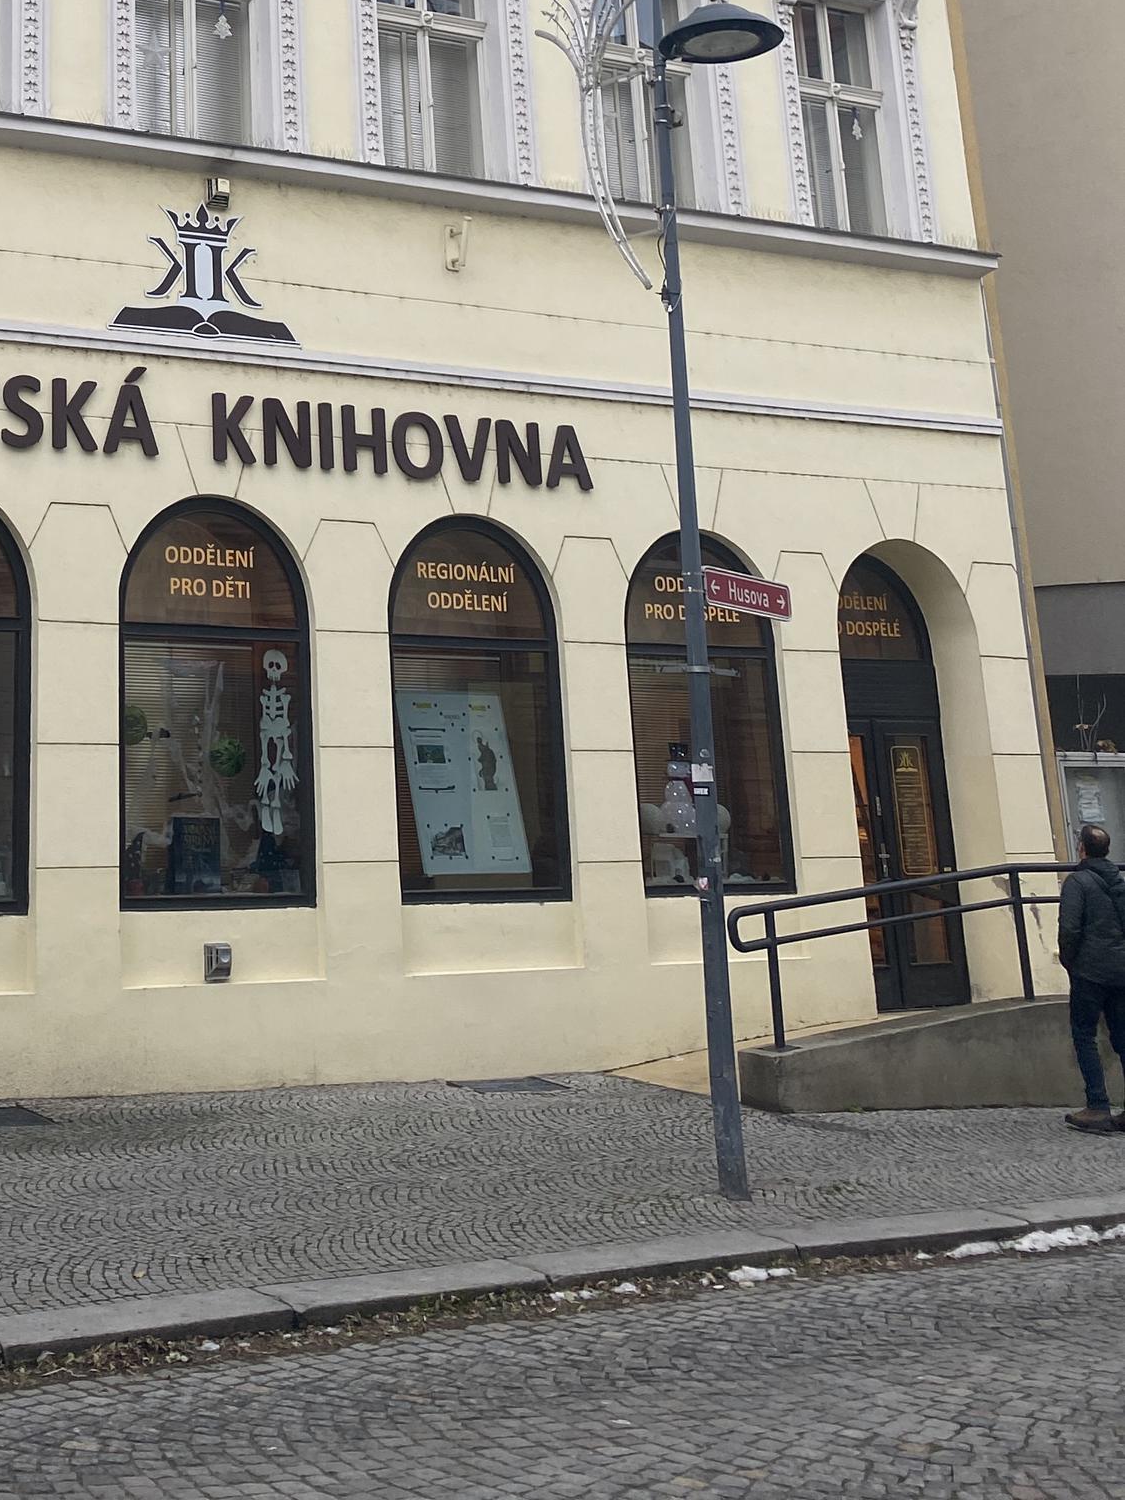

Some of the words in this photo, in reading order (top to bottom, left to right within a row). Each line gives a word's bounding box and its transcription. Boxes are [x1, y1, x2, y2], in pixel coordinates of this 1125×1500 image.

[211, 391, 594, 491] KNIHOVNA
[165, 543, 254, 568] ODDĚLENÍ
[417, 561, 515, 584] REGIONÁLNÍ
[170, 577, 206, 596] PRO
[212, 575, 251, 599] DĚTI
[728, 579, 770, 608] Husova
[427, 589, 508, 612] ODDĚLENÍ
[644, 603, 675, 621] PRO
[846, 618, 902, 637] DOSPĚLÉ
